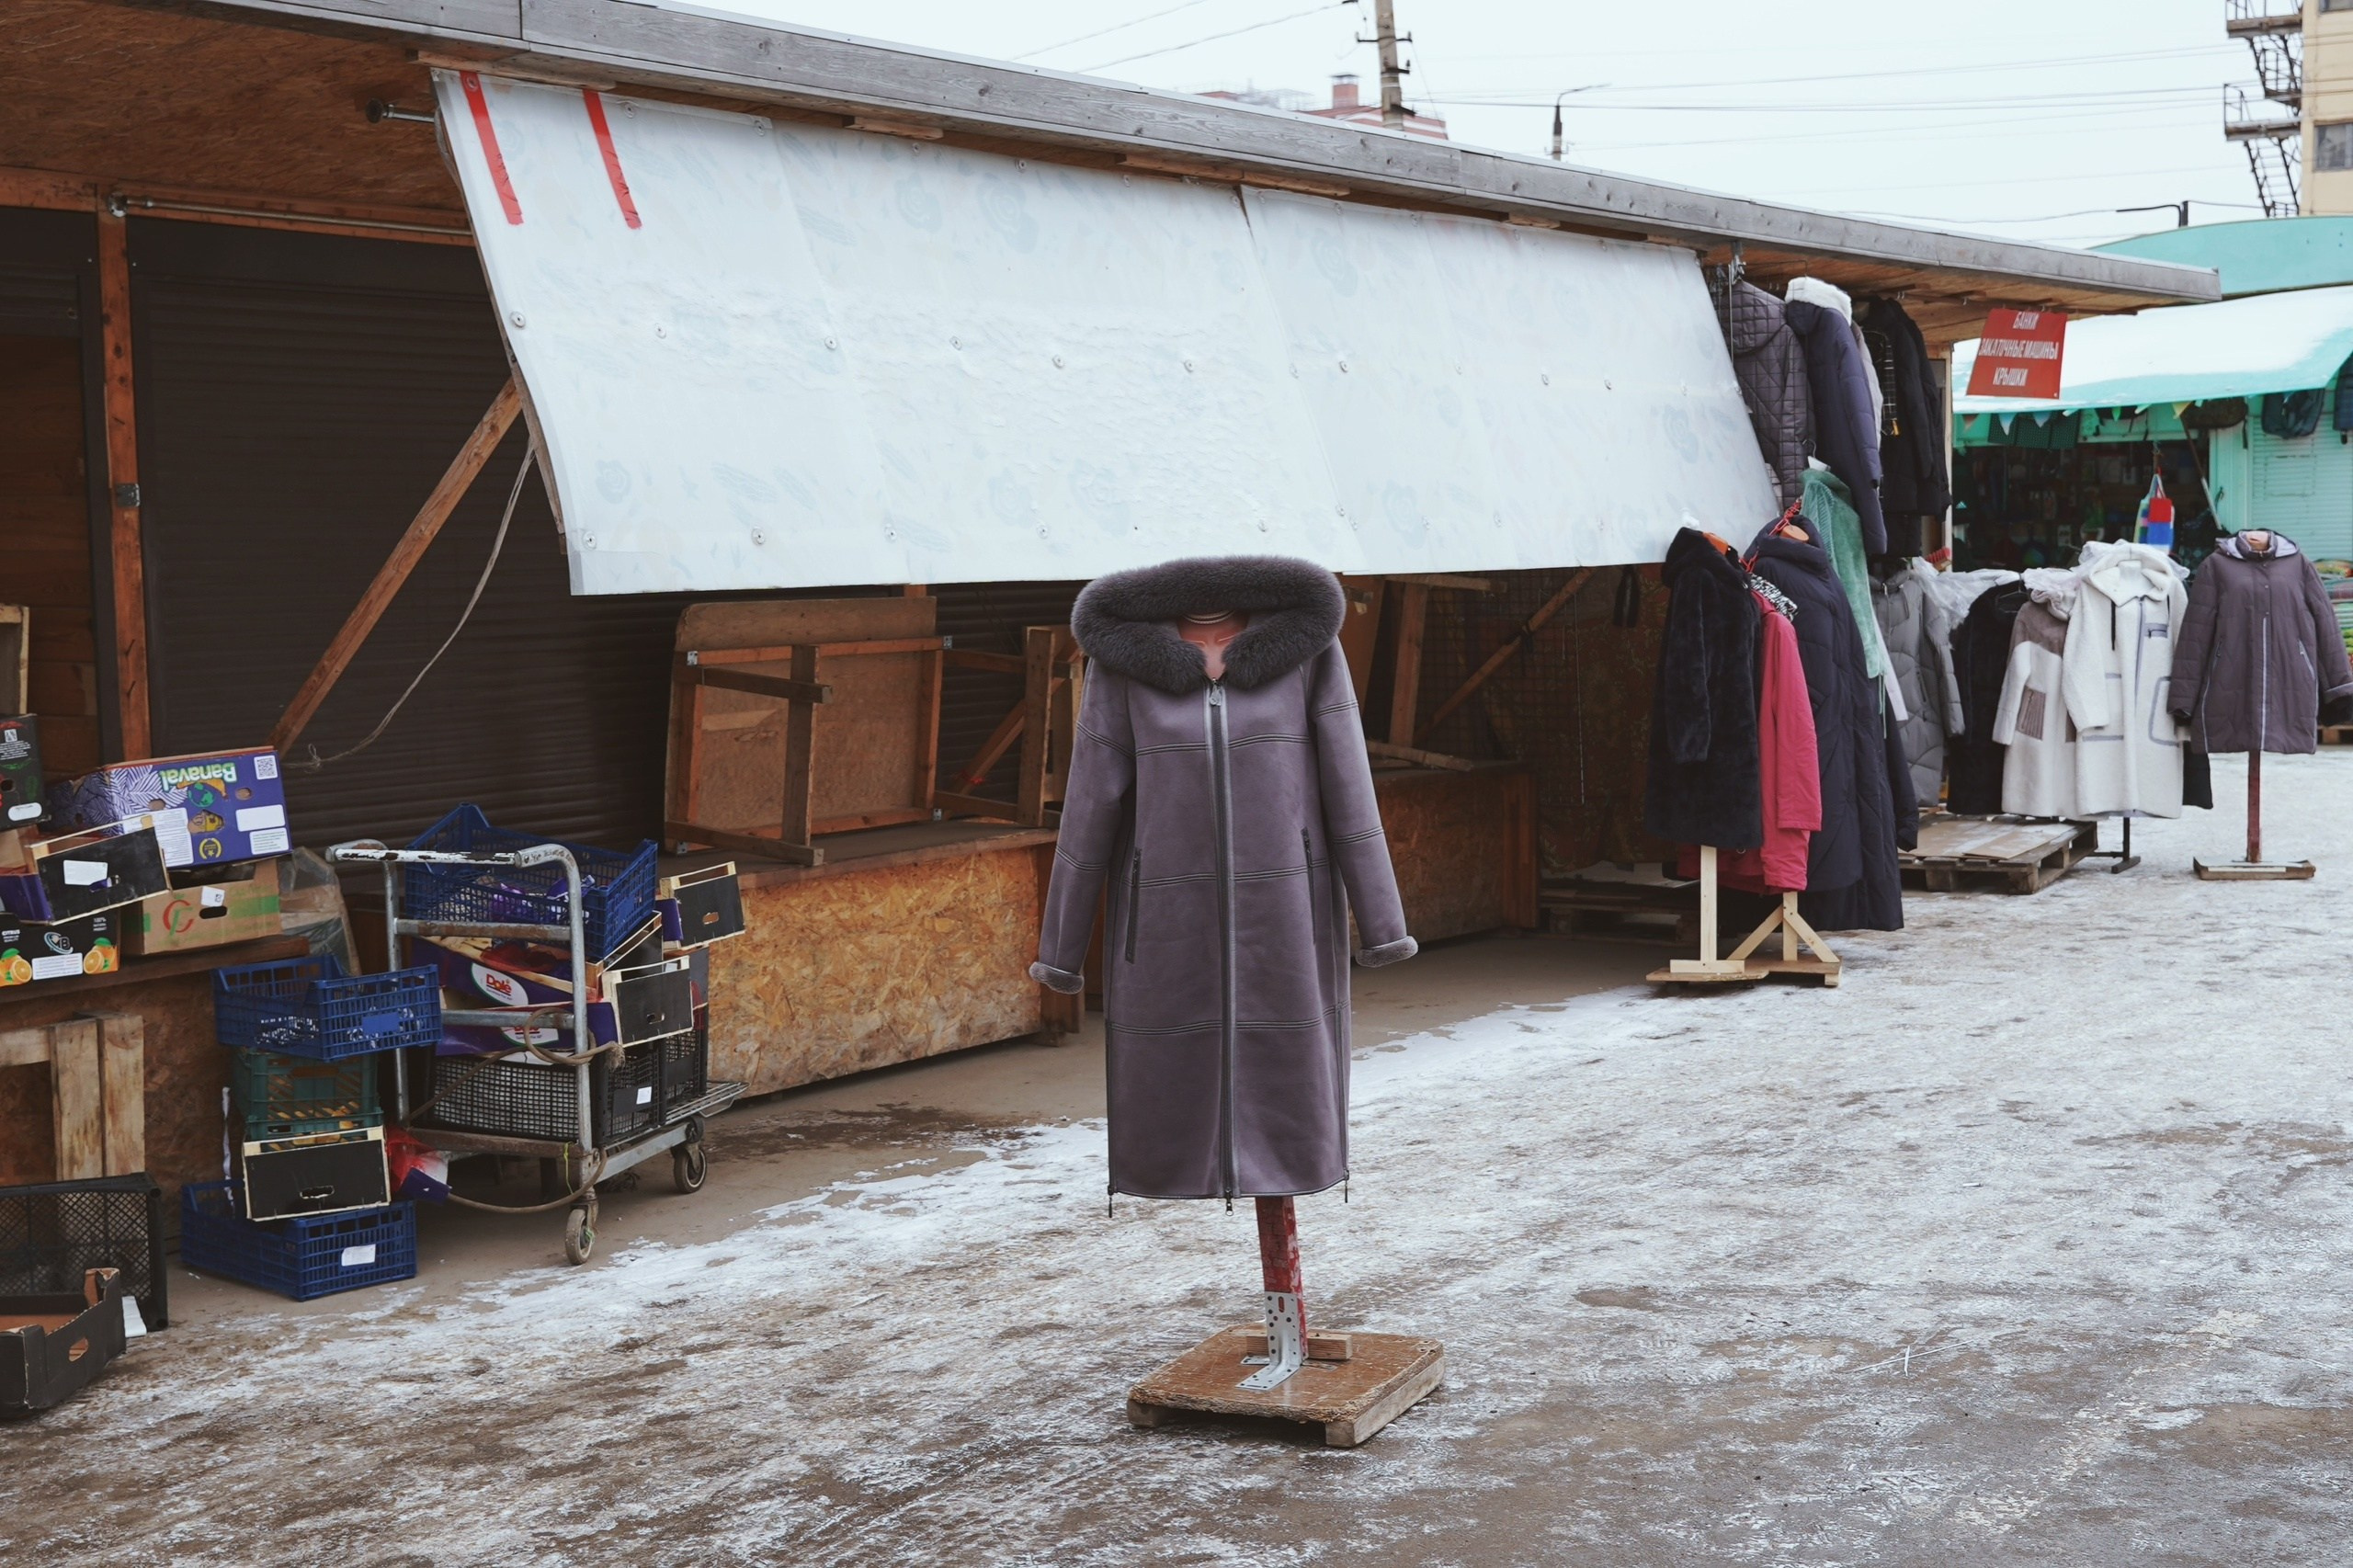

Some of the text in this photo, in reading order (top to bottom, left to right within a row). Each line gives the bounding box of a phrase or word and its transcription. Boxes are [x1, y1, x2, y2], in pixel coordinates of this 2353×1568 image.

[2013, 311, 2040, 329] БАНКИ
[2023, 340, 2059, 360] МАШИНЫ
[1993, 367, 2029, 386] КРЫШКИ
[159, 762, 237, 791] Banaval
[485, 972, 512, 994] Dole
